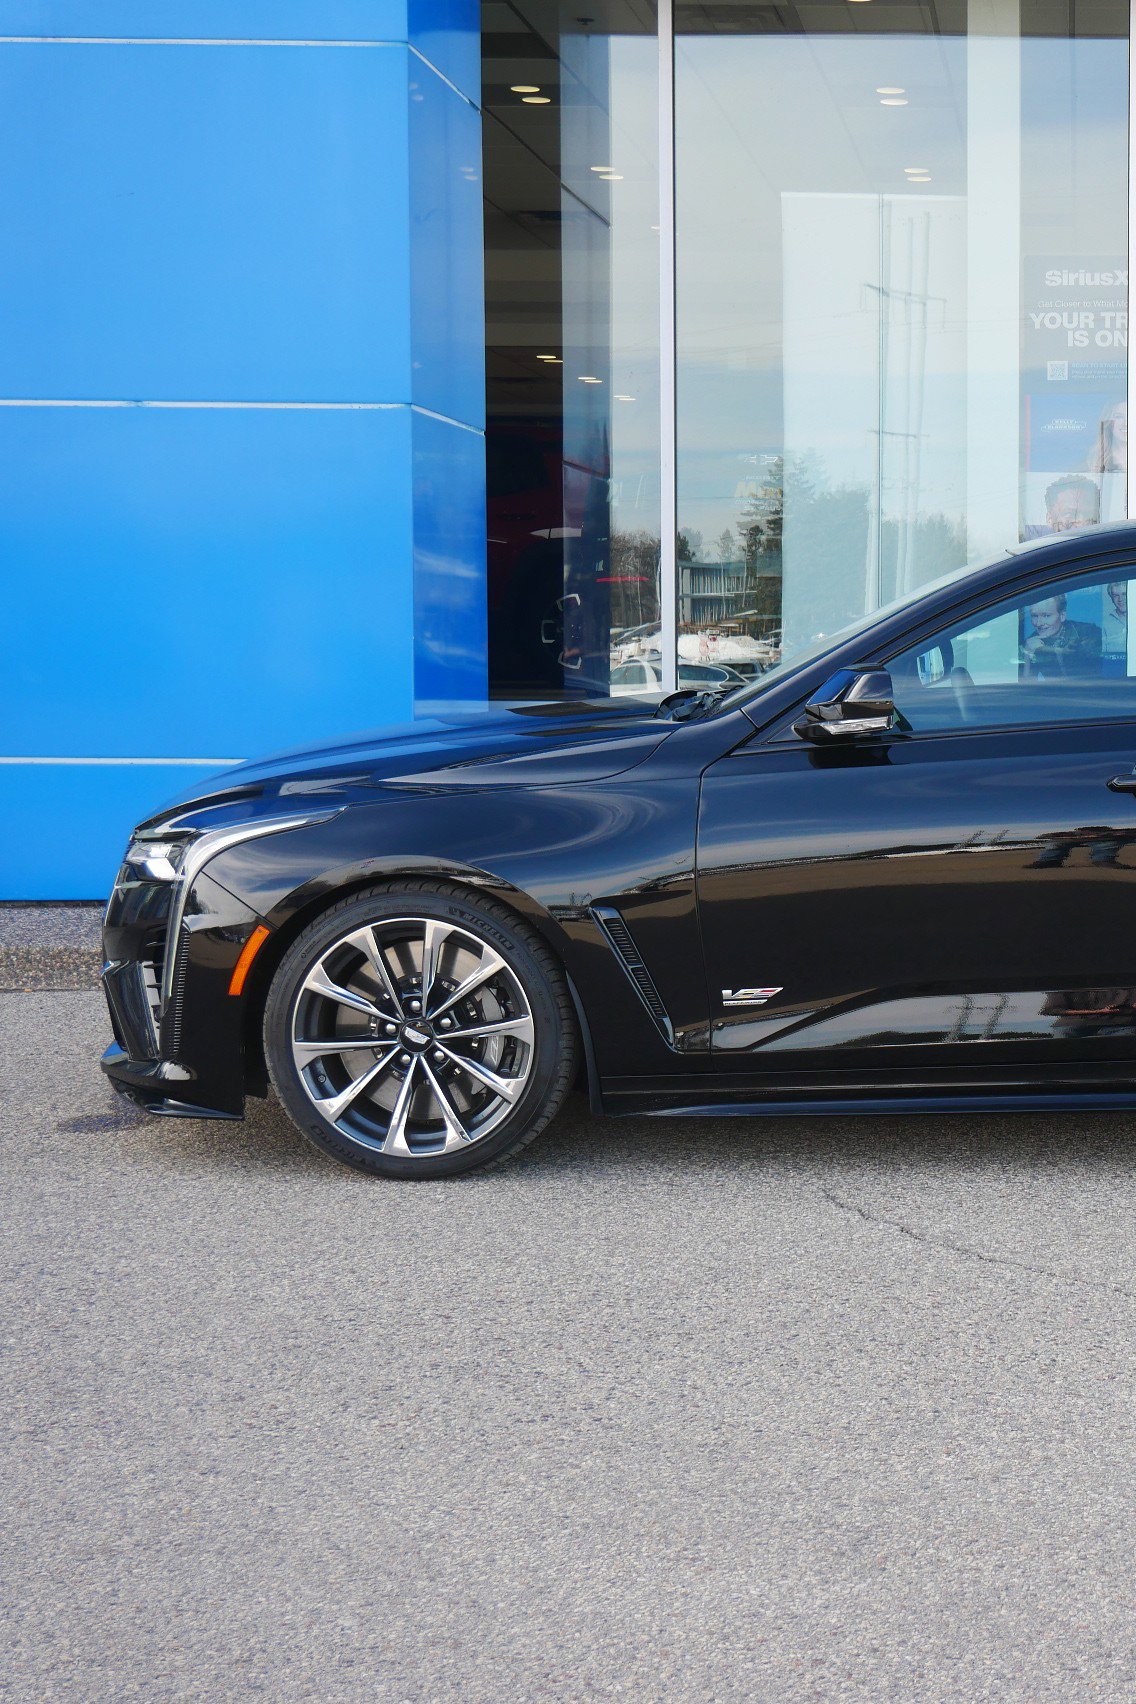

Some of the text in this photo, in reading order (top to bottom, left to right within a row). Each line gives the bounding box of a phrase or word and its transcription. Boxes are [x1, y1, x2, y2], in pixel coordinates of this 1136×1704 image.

[1054, 300, 1081, 308] Closer
[1093, 300, 1114, 308] What
[1029, 312, 1095, 329] YOUR
[1067, 330, 1128, 347] IS ON
